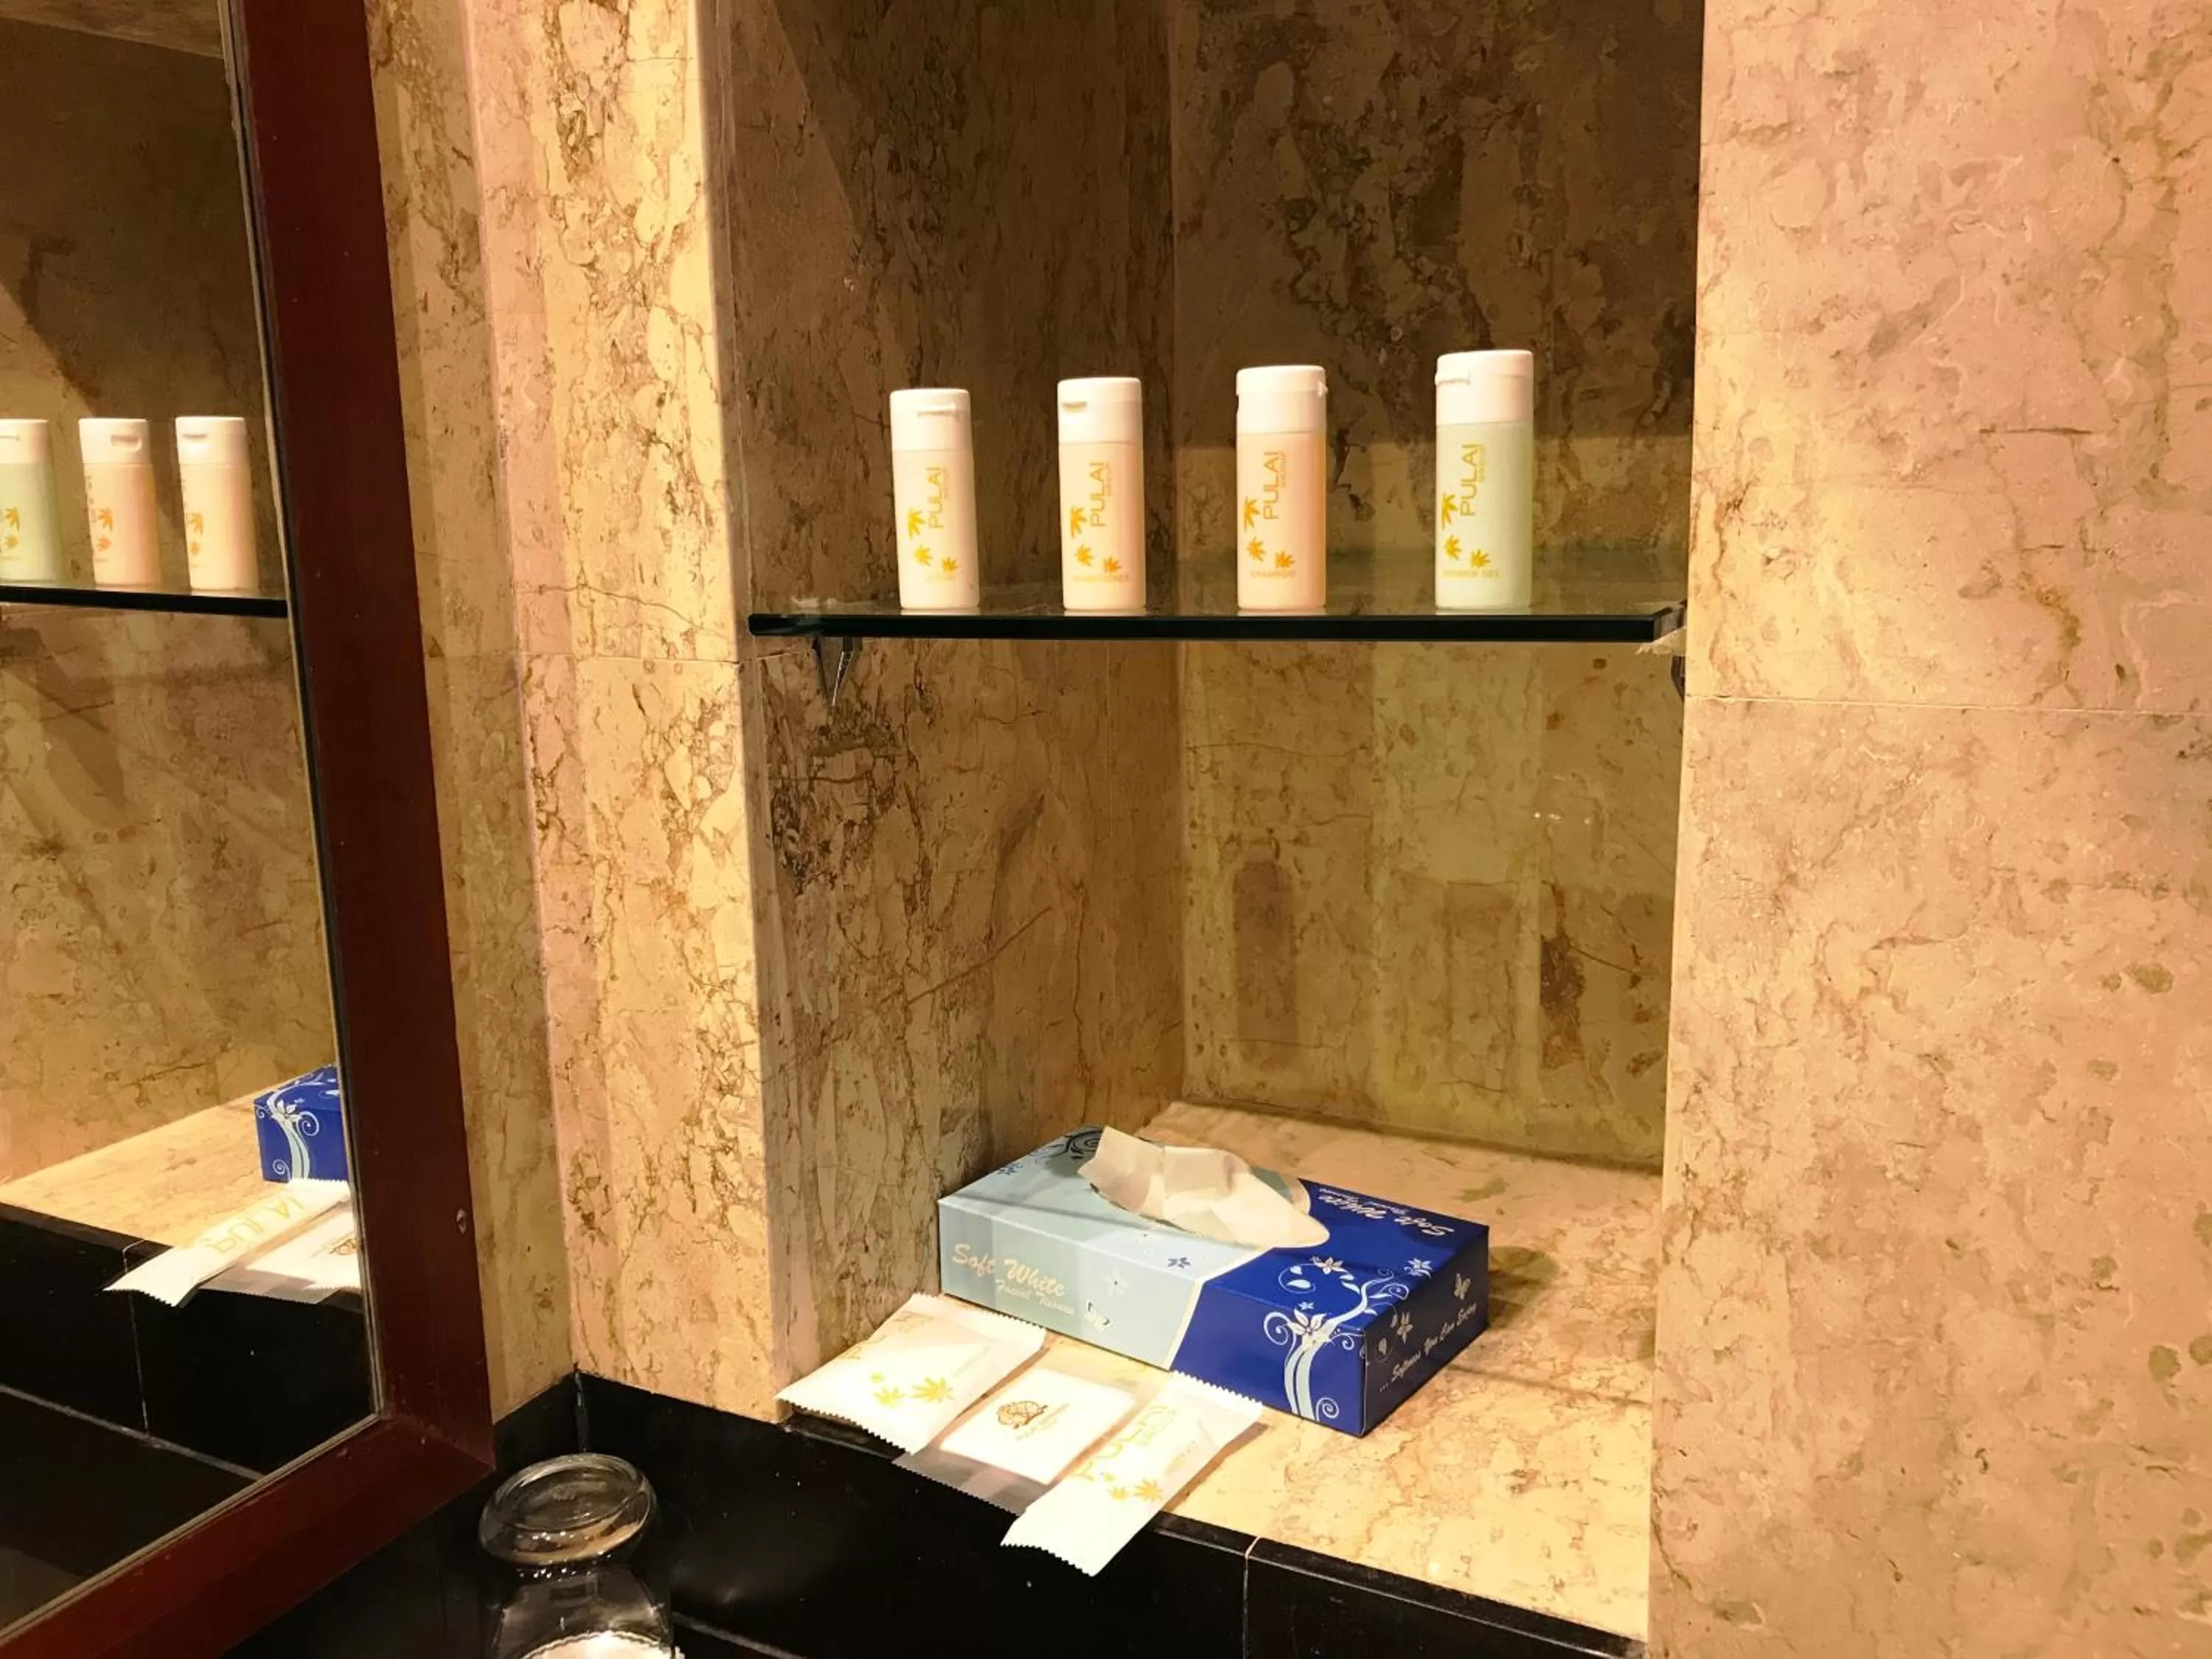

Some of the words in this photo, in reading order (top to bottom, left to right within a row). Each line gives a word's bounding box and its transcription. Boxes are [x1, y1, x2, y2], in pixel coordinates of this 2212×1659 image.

[926, 466, 945, 529] PULAI
[1089, 462, 1106, 528] PULAI
[1263, 451, 1280, 521] PULAI
[1460, 444, 1481, 517] PULAI
[953, 1243, 995, 1278] Soft
[1004, 1258, 1064, 1298] White
